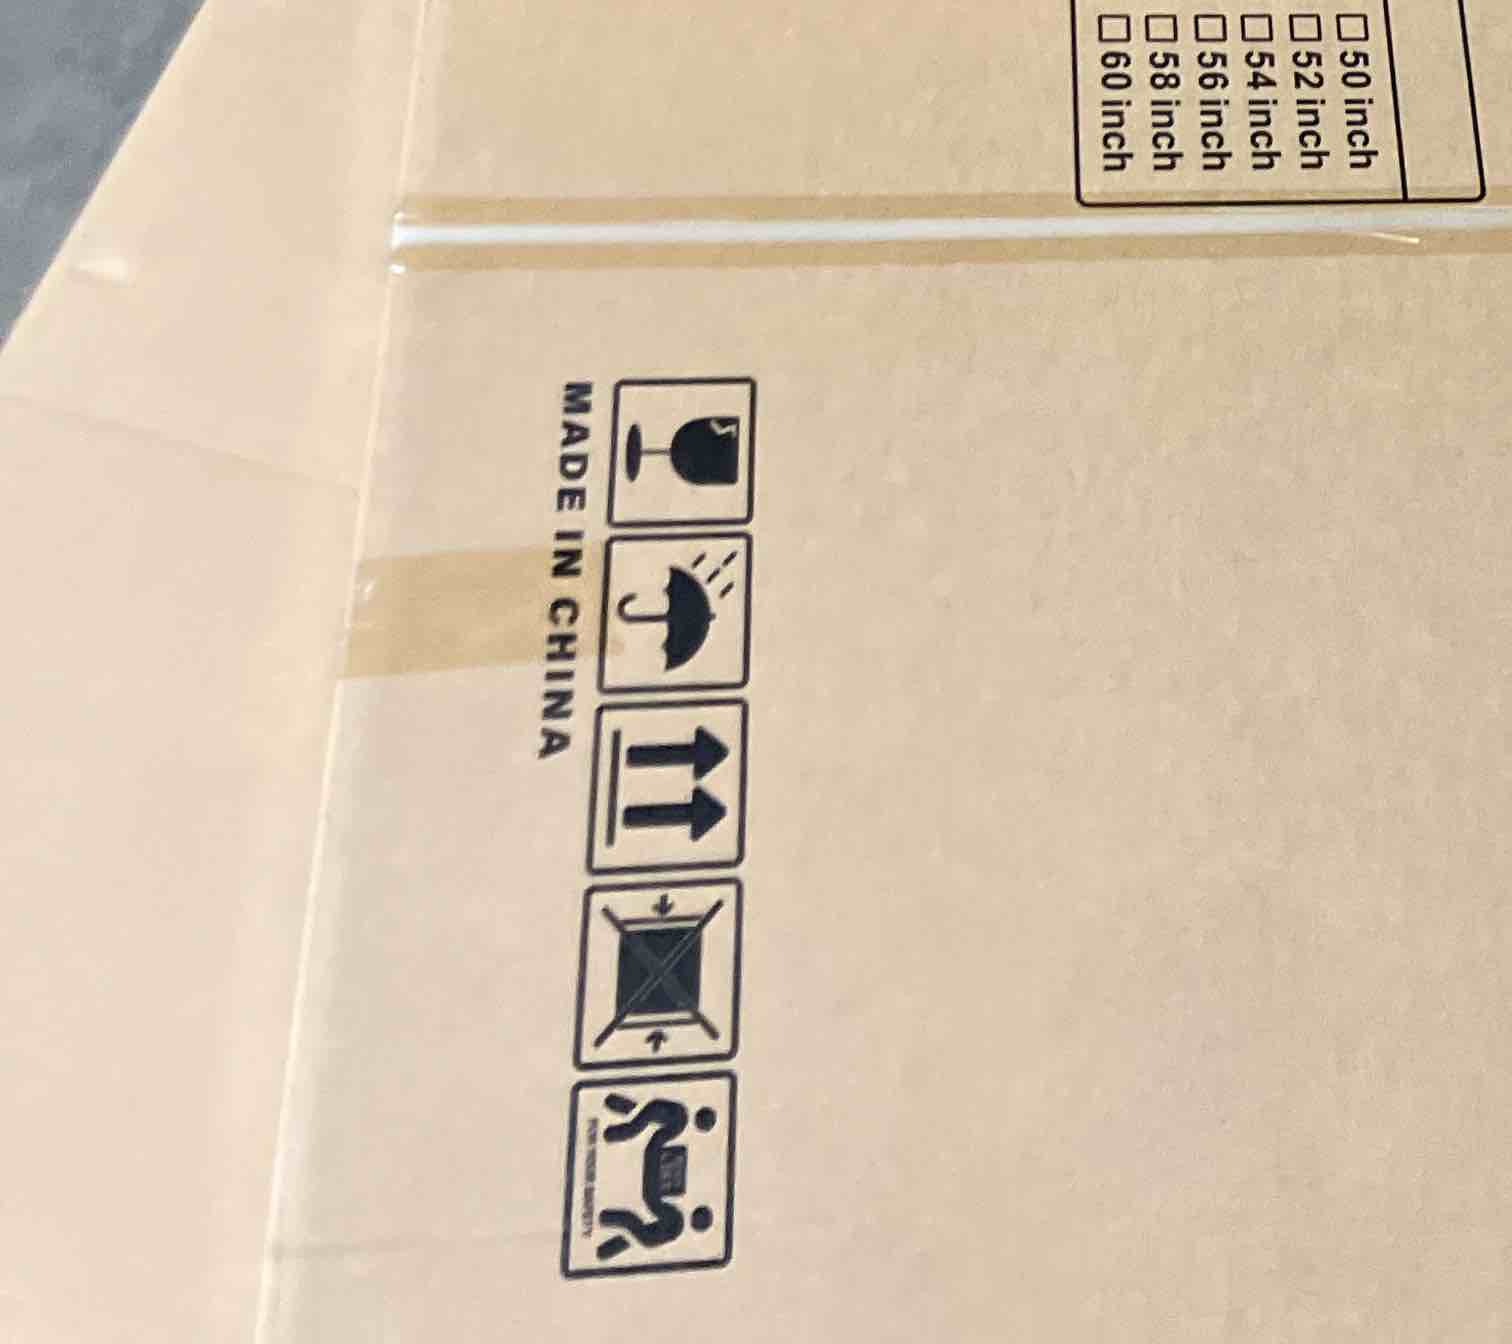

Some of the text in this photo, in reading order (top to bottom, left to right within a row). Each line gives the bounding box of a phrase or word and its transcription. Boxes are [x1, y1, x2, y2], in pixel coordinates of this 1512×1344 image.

[1101, 51, 1134, 172] 60 inch
[1149, 51, 1184, 171] 58 inch
[1197, 51, 1232, 171] 56 inch
[1245, 50, 1282, 171] 54 inch
[1292, 51, 1330, 170] 52 inch
[1340, 50, 1379, 168] 50 inch
[539, 383, 592, 758] MADE IN CHINA
